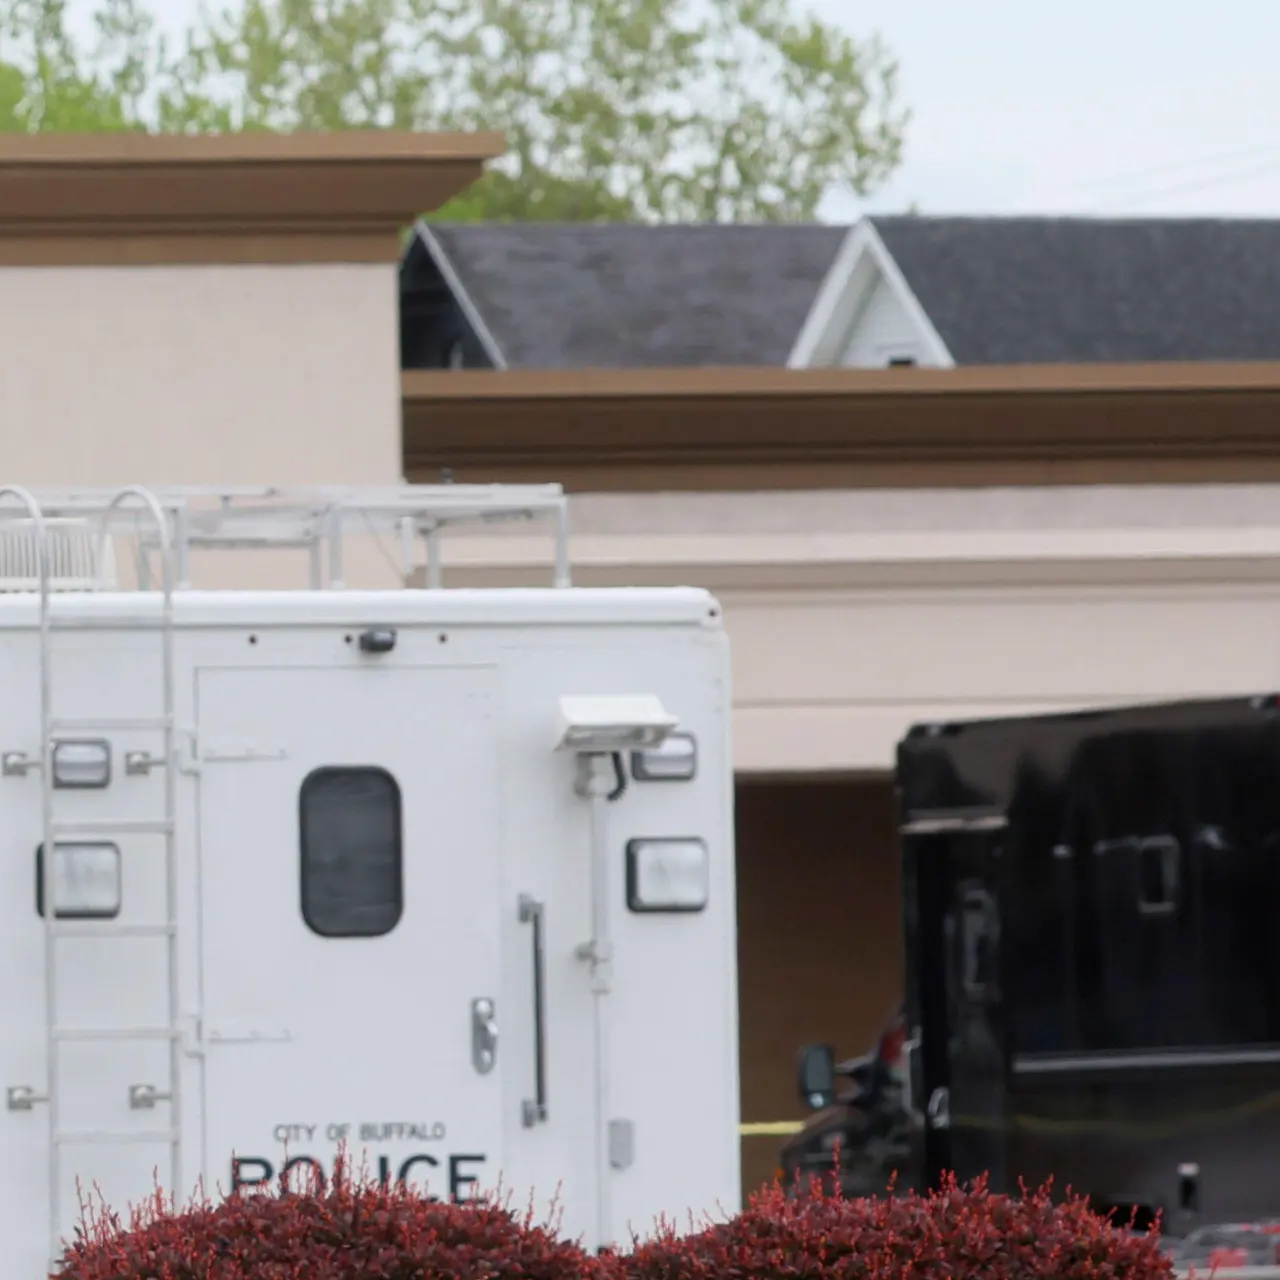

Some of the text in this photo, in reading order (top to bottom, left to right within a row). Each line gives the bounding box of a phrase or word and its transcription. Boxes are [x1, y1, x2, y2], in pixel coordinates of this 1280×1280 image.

[273, 1122, 446, 1142] CITY OF BUFFALO
